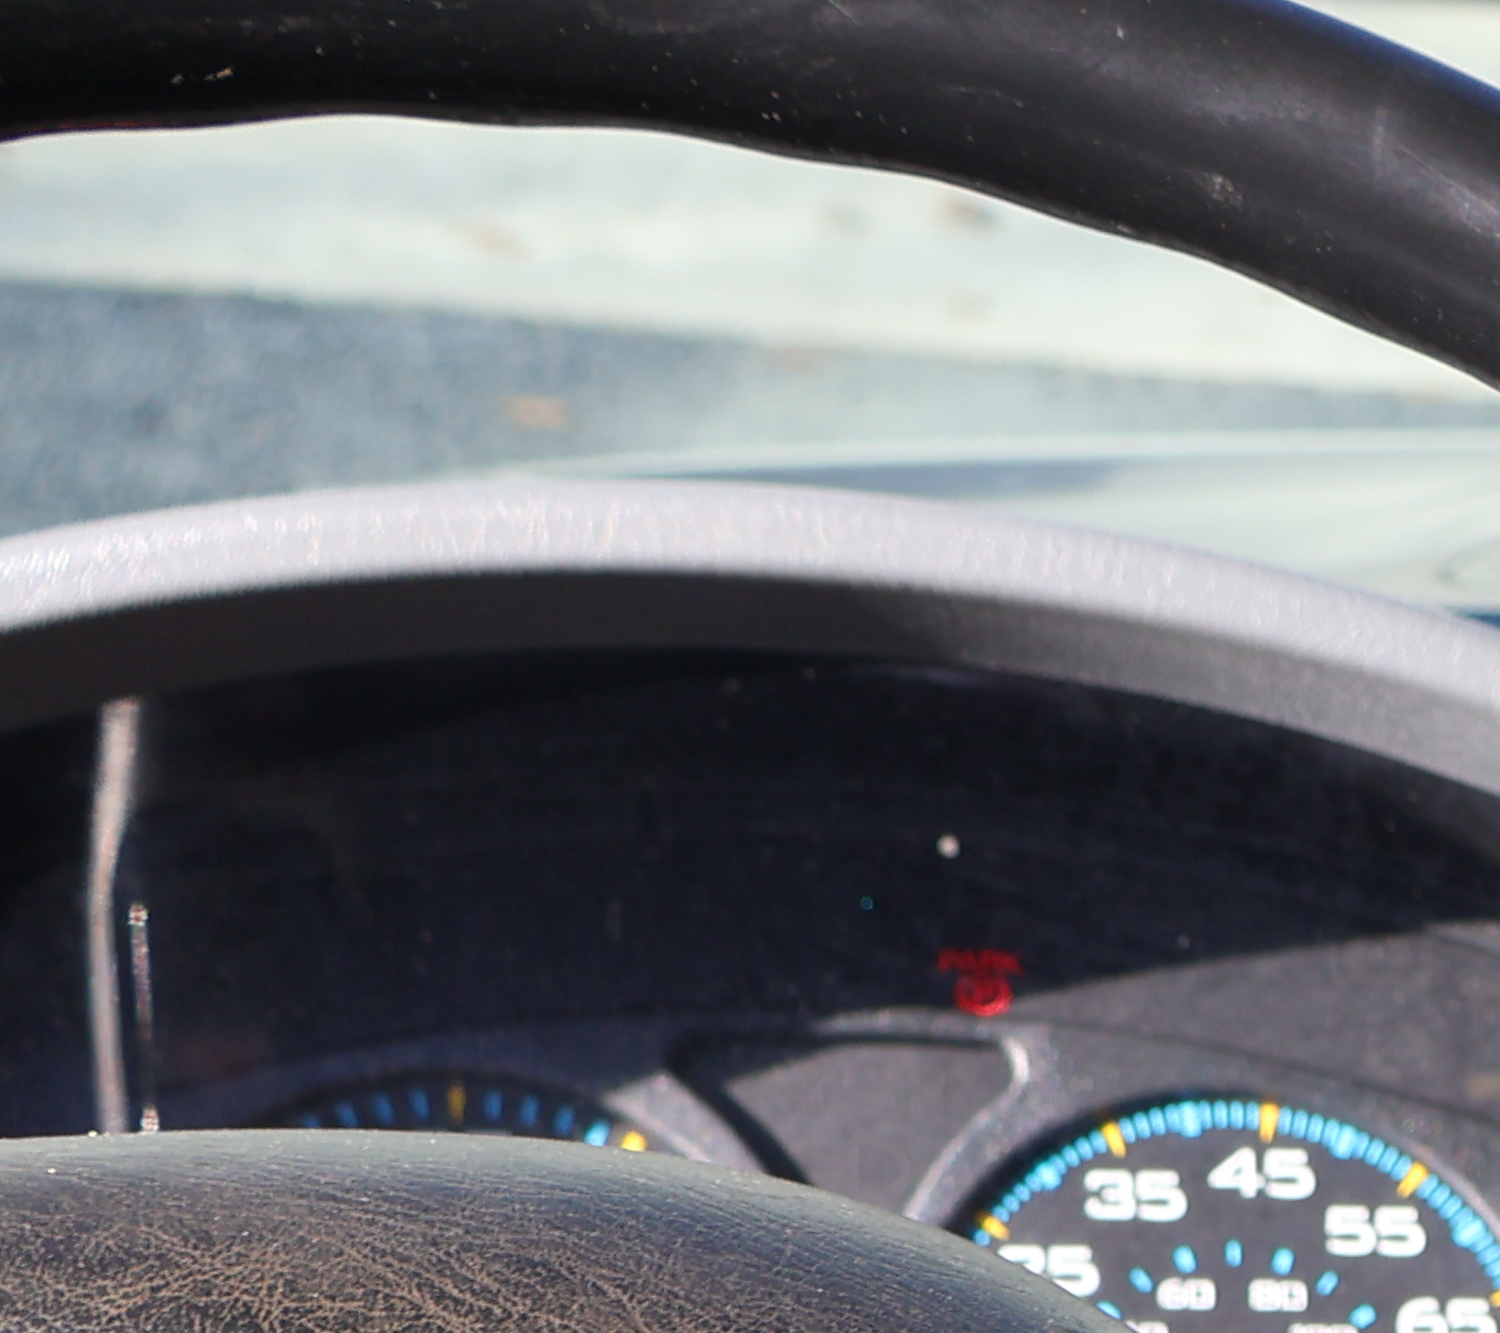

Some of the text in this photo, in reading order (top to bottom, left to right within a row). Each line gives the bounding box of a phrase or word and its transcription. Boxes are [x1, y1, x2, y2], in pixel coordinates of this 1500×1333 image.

[1084, 1169, 1187, 1221] 35
[1207, 1146, 1316, 1199] 45
[1325, 1204, 1426, 1257] 55
[1156, 1277, 1216, 1311] 60
[1248, 1277, 1308, 1312] 80
